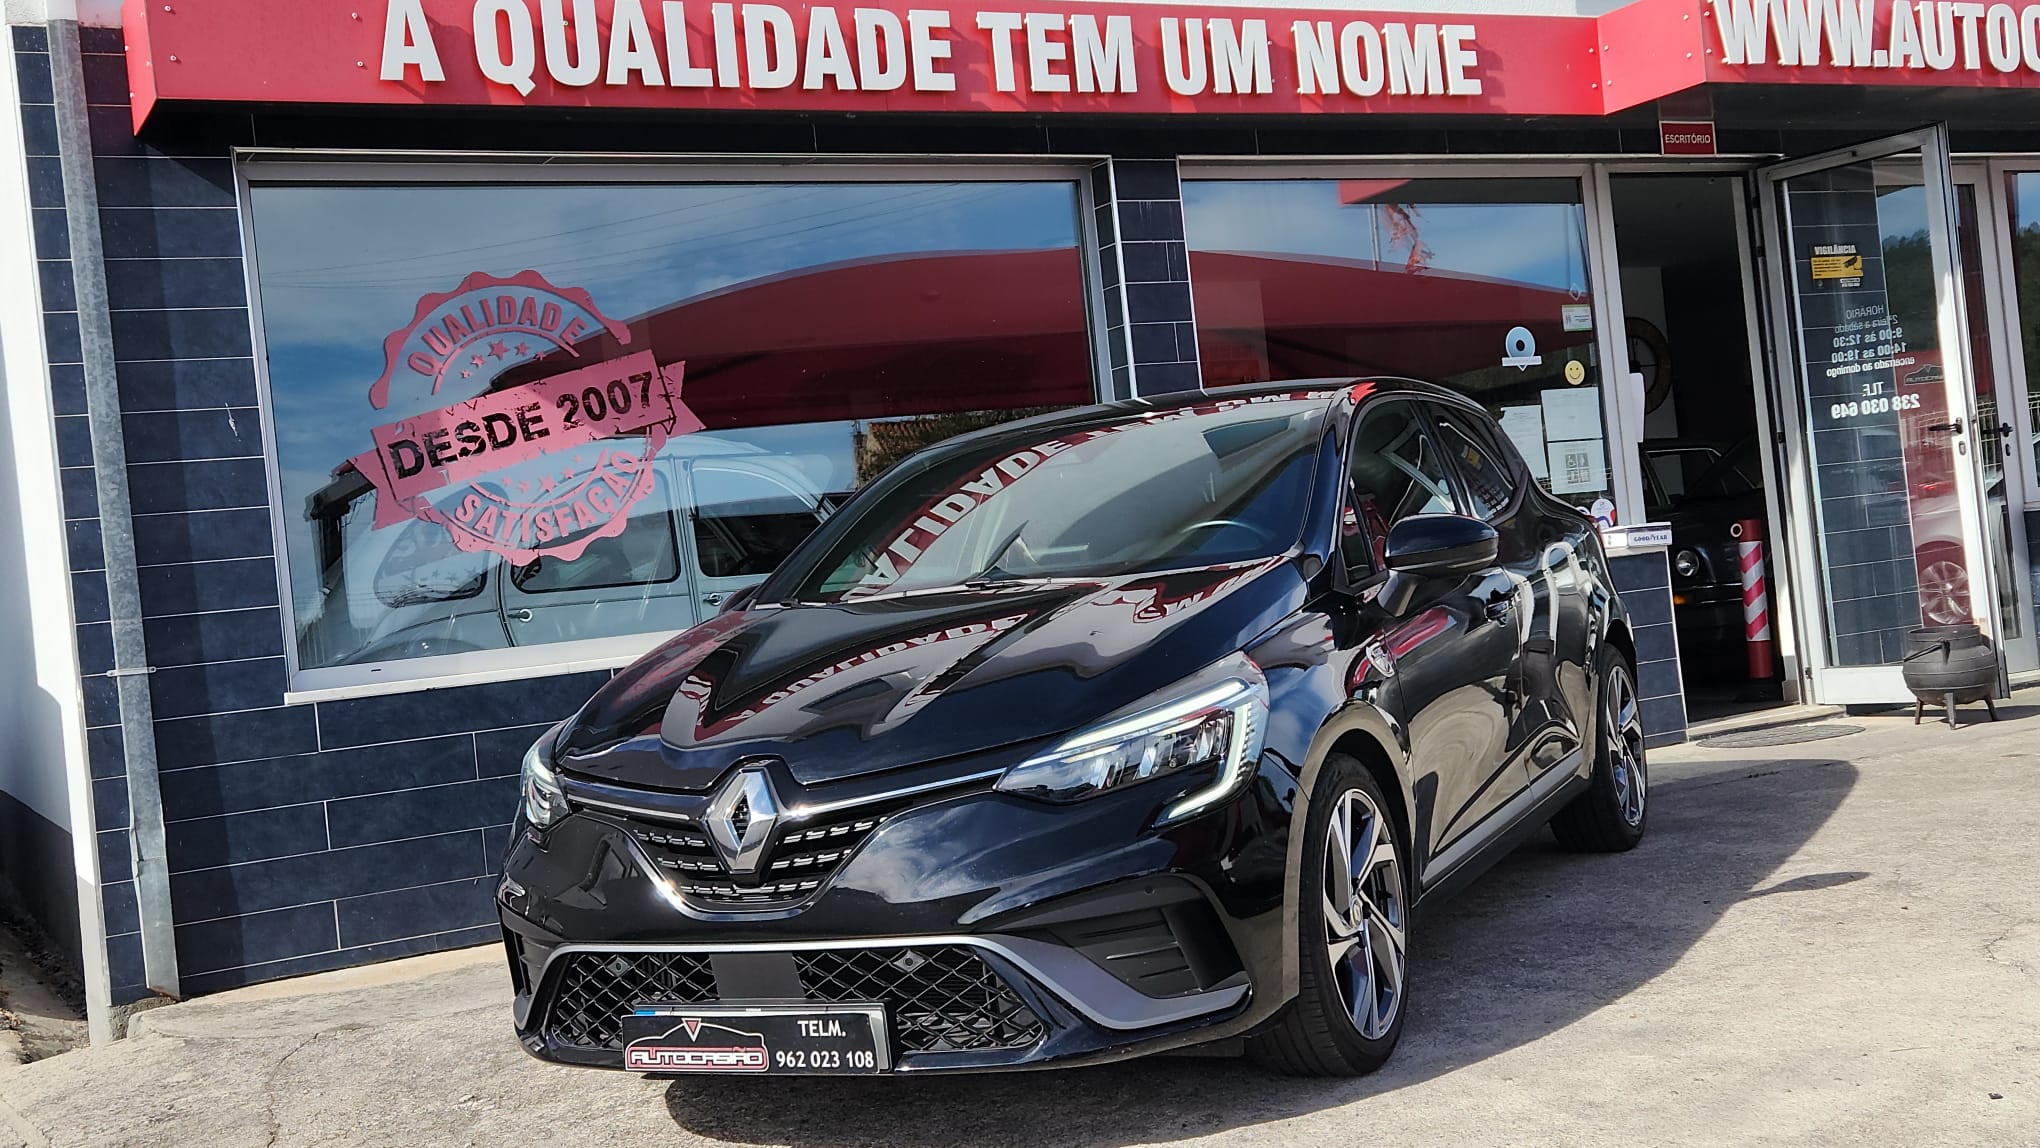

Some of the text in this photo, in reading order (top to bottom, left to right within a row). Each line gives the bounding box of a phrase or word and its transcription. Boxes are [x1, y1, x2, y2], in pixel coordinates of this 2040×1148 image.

[379, 0, 1484, 97] A QUALIDADE TEM UM NOME
[1664, 132, 1711, 144] ESCRITÓRIO
[408, 294, 588, 377] QUALIDADE
[387, 371, 655, 480] DESDE 2007
[798, 1019, 846, 1037] TELM.
[775, 1050, 806, 1068] 962
[810, 1050, 840, 1067] 023
[846, 1049, 874, 1067] 108
